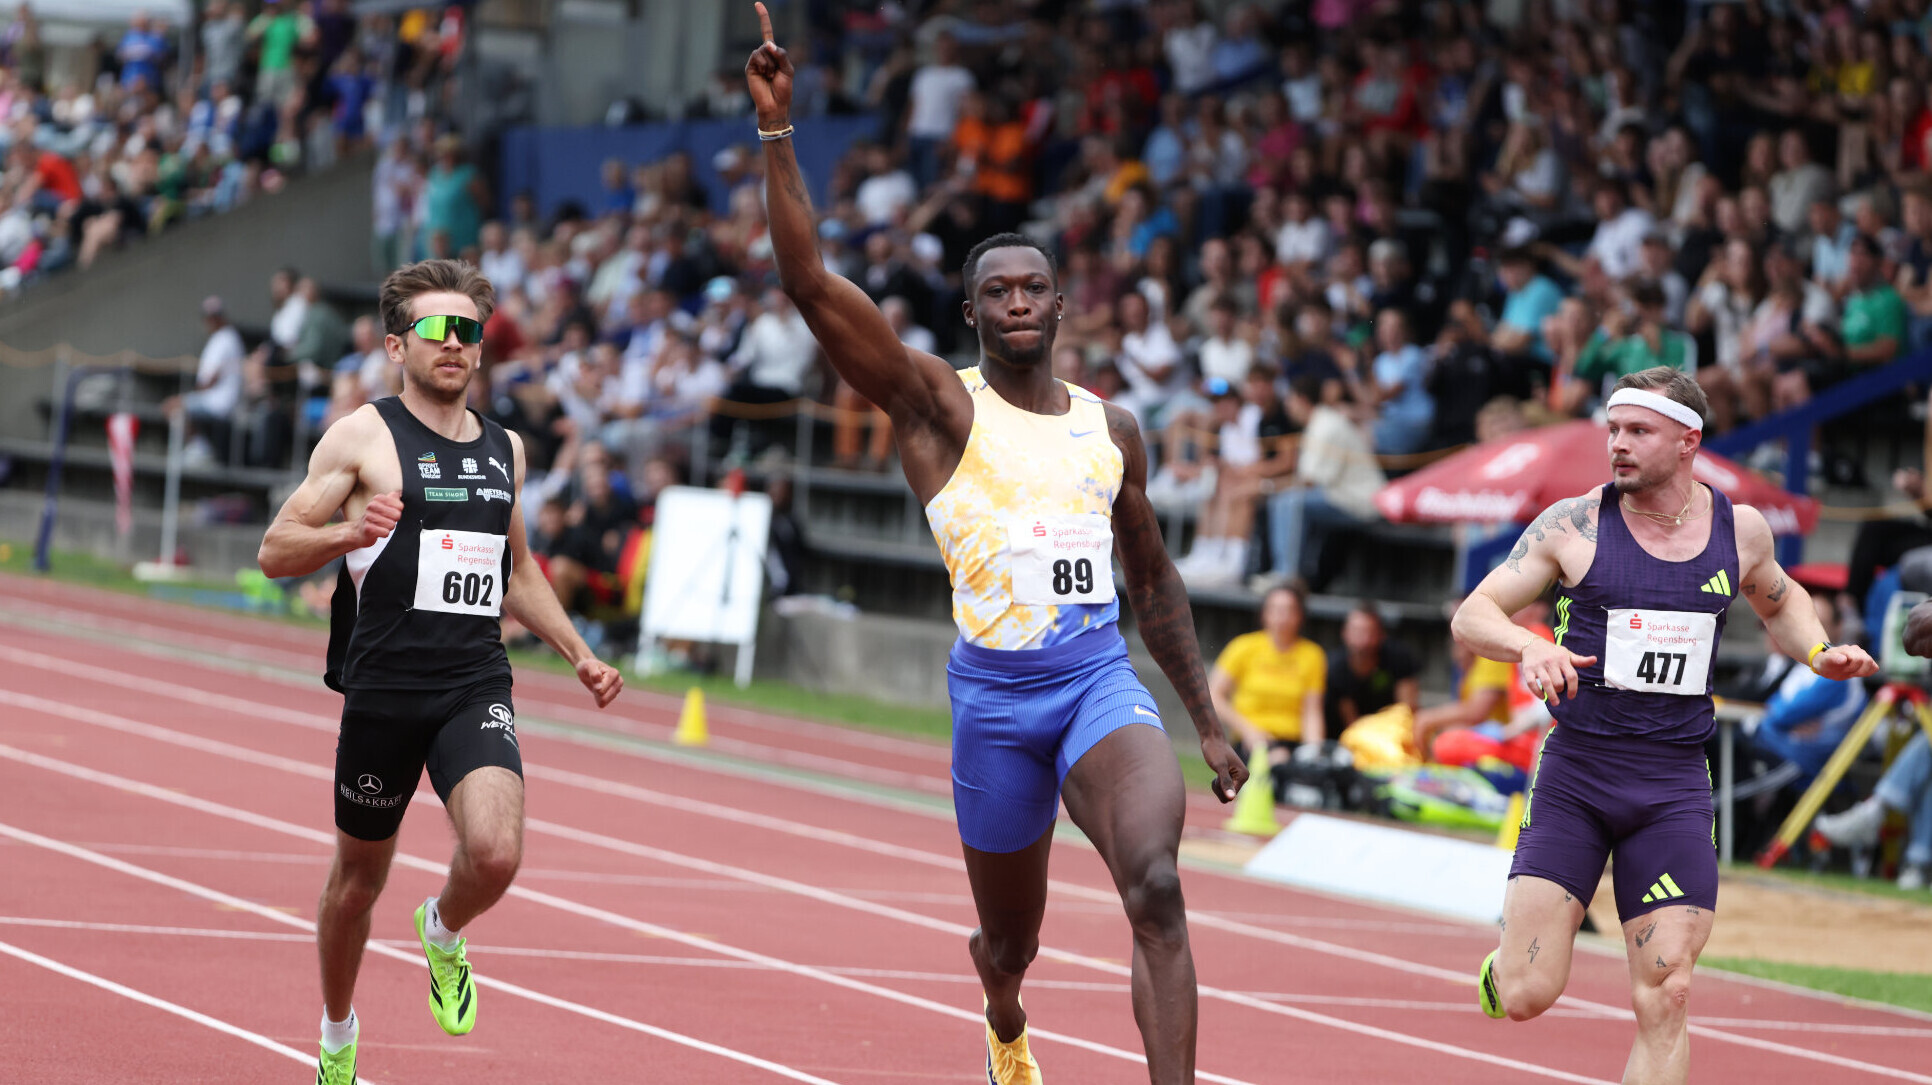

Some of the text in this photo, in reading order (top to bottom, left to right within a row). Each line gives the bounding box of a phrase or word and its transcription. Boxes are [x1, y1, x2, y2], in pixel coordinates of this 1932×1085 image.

[442, 570, 494, 607] 602
[1052, 557, 1094, 596] 89
[1647, 621, 1690, 633] Sparkasse
[1647, 633, 1697, 647] Regensburg
[1636, 651, 1687, 686] 477
